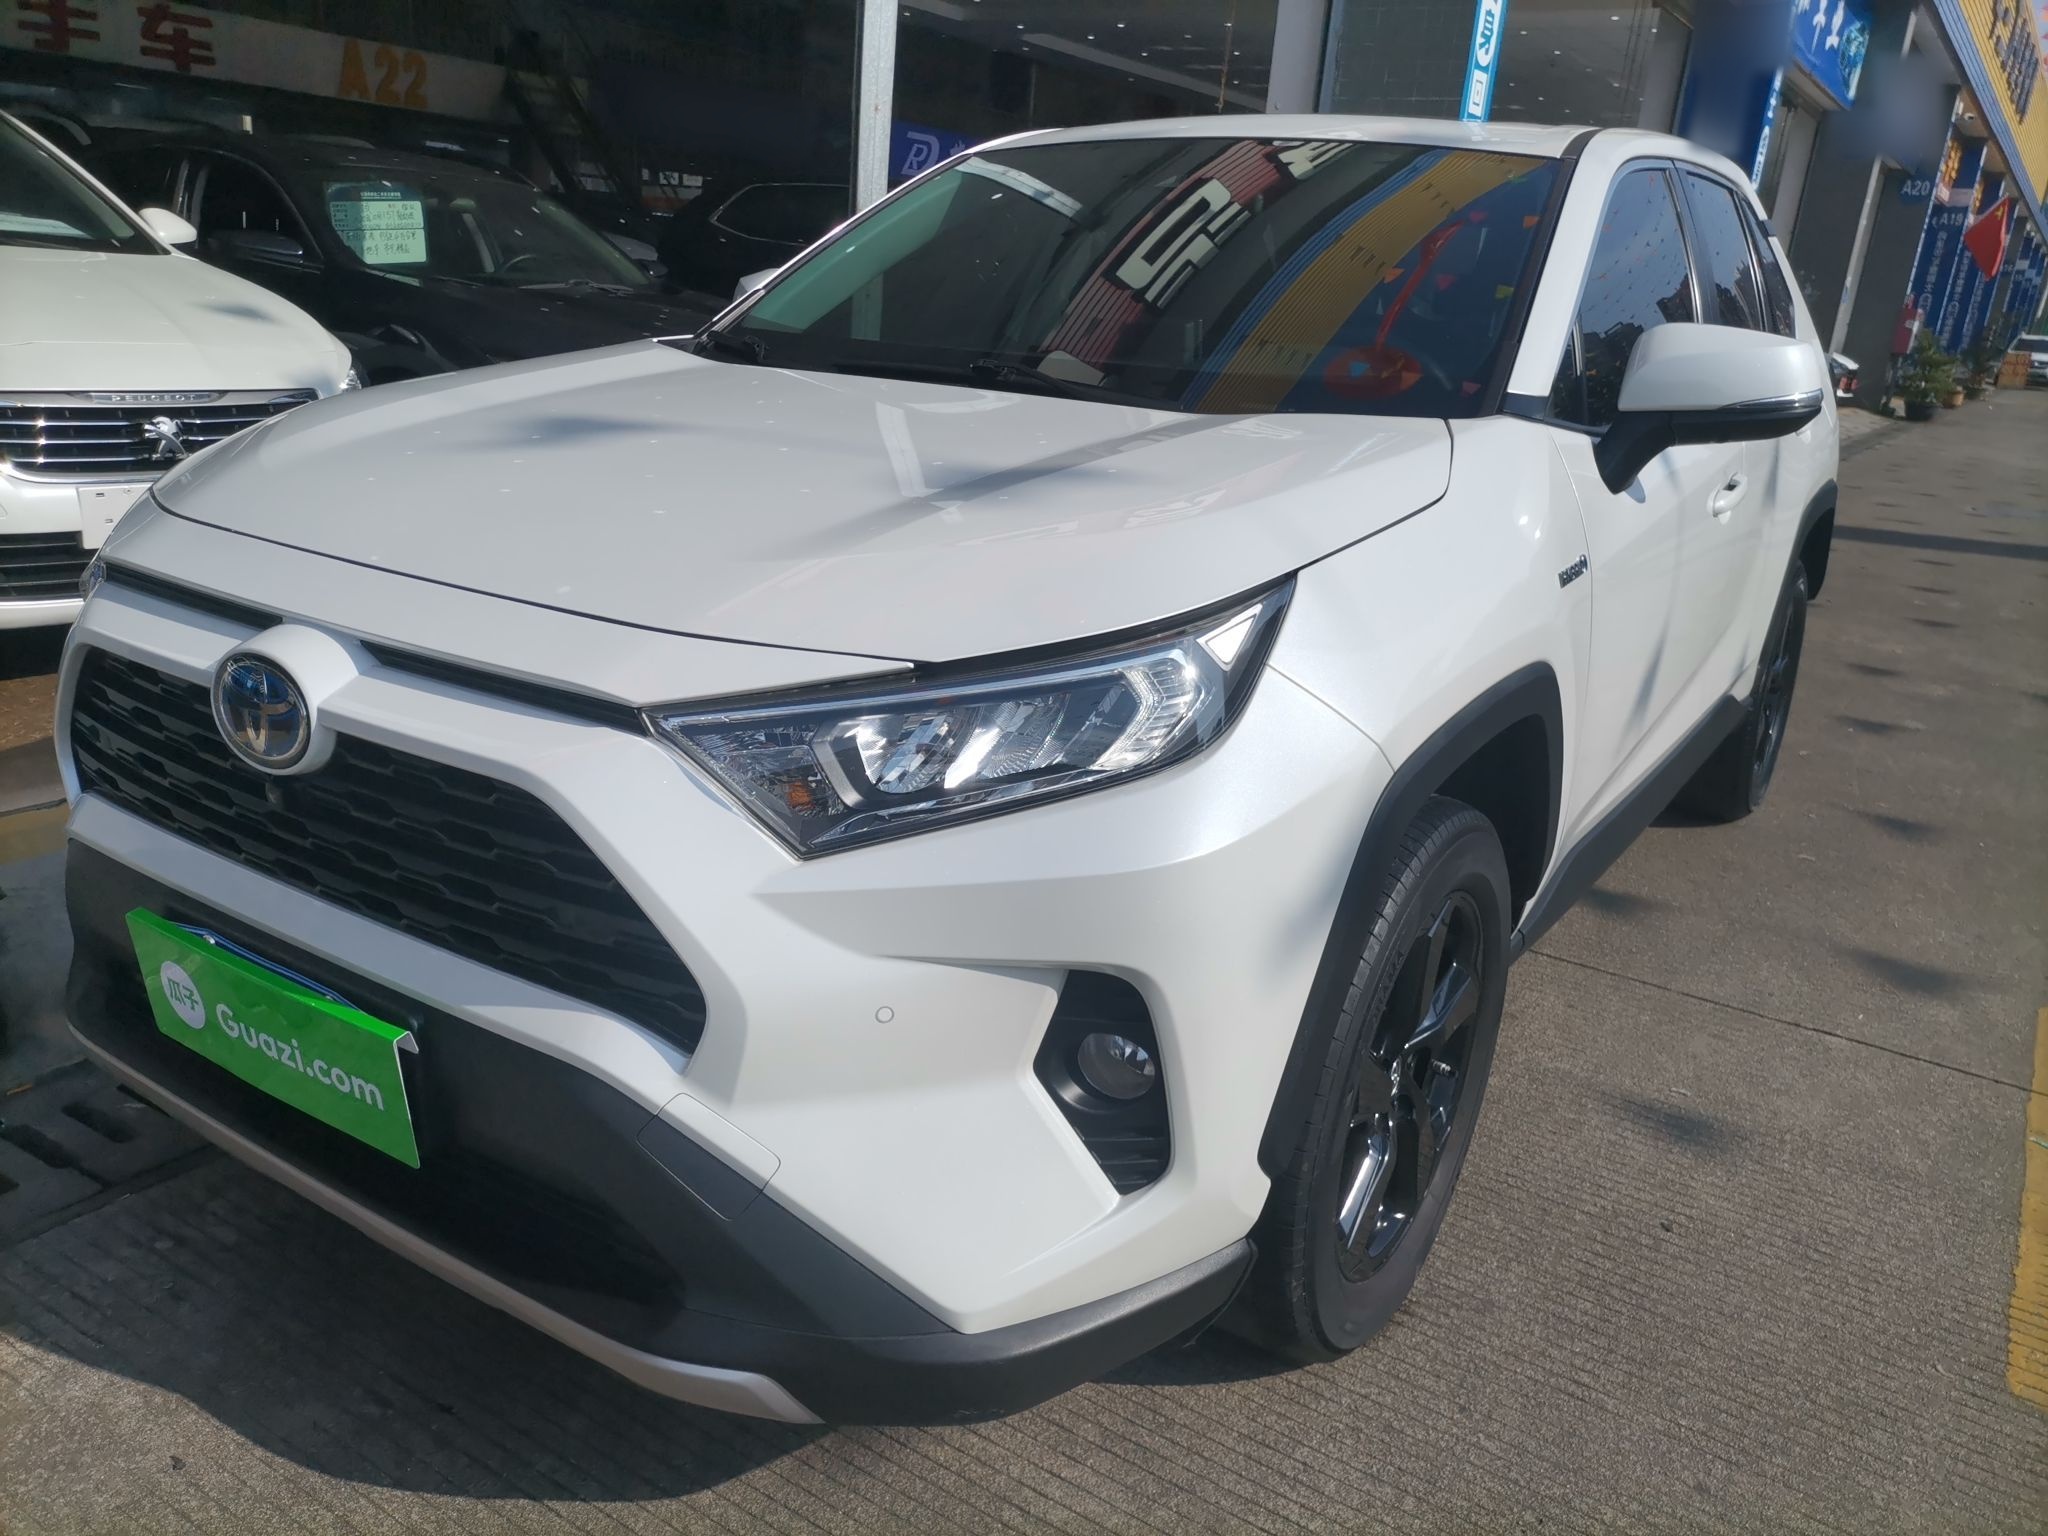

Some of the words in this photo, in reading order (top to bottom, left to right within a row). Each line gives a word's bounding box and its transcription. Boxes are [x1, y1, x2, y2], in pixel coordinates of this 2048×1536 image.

[338, 39, 429, 110] A22
[1900, 180, 1930, 196] A20
[1938, 212, 1964, 226] A19
[111, 394, 197, 402] PEUGEOT
[167, 976, 199, 1012] 瓜子
[216, 1003, 385, 1111] Guazi.com
